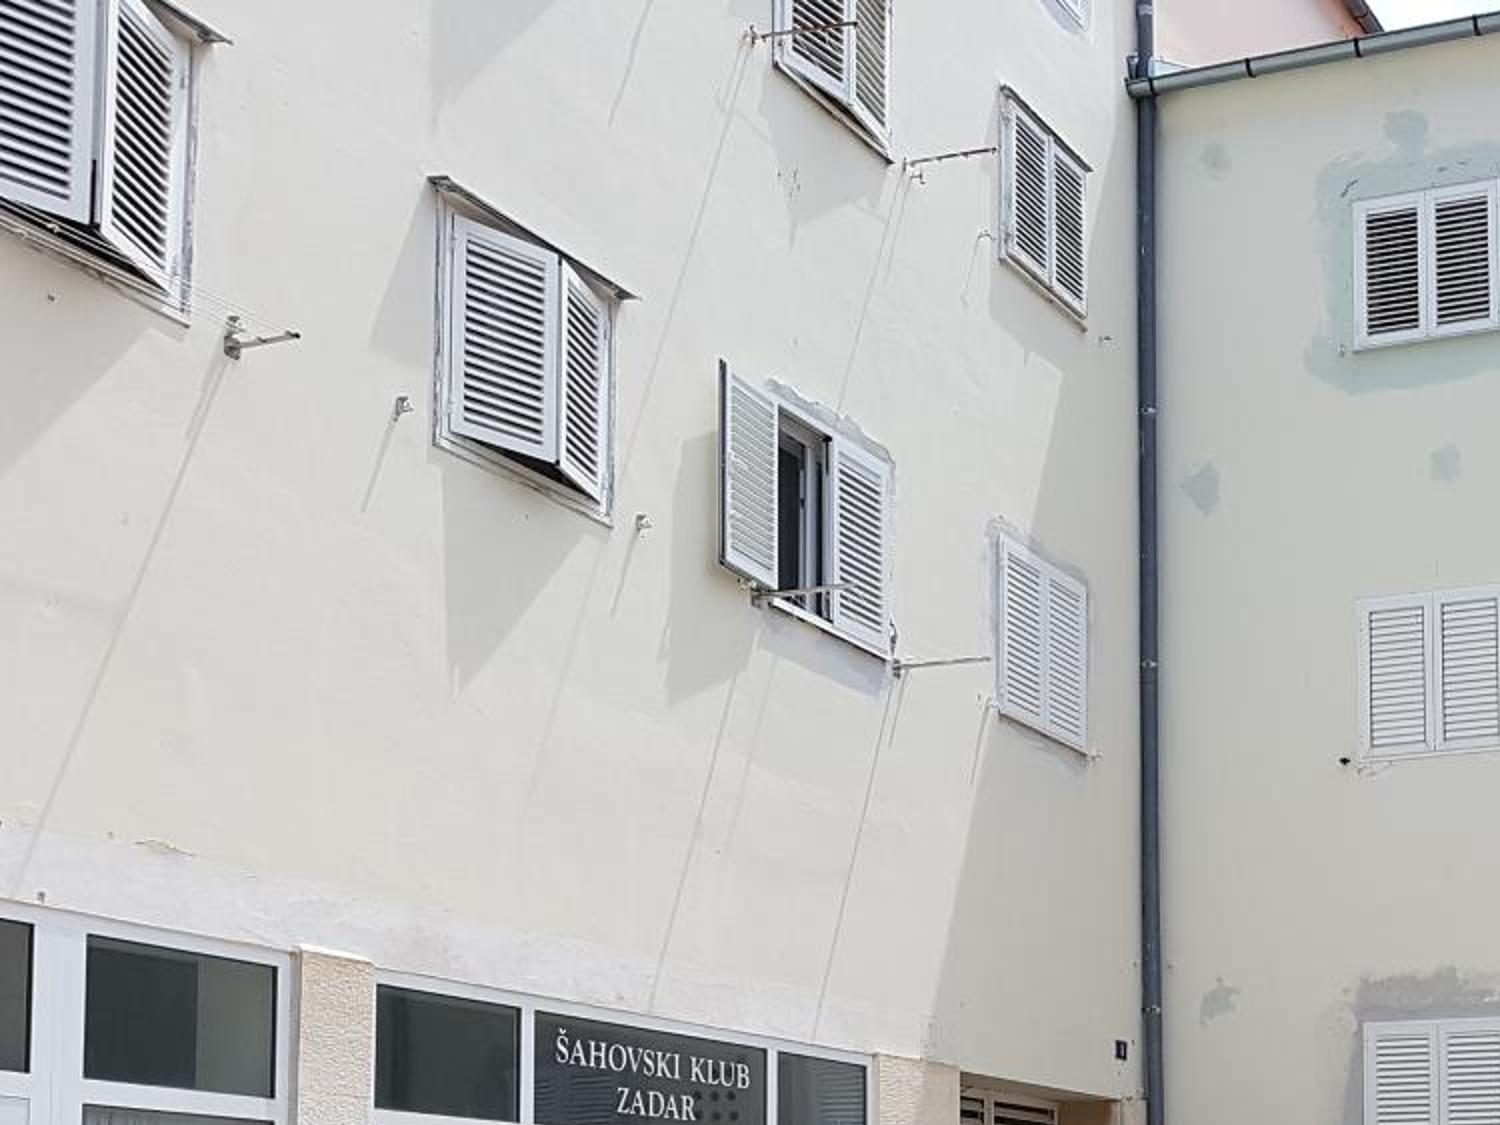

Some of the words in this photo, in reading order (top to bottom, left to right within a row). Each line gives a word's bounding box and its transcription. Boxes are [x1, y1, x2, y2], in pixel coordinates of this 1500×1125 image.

[555, 1028, 681, 1081] ŠAHOVSKI
[690, 1056, 751, 1089] KLUB
[616, 1086, 697, 1121] ZADAR
